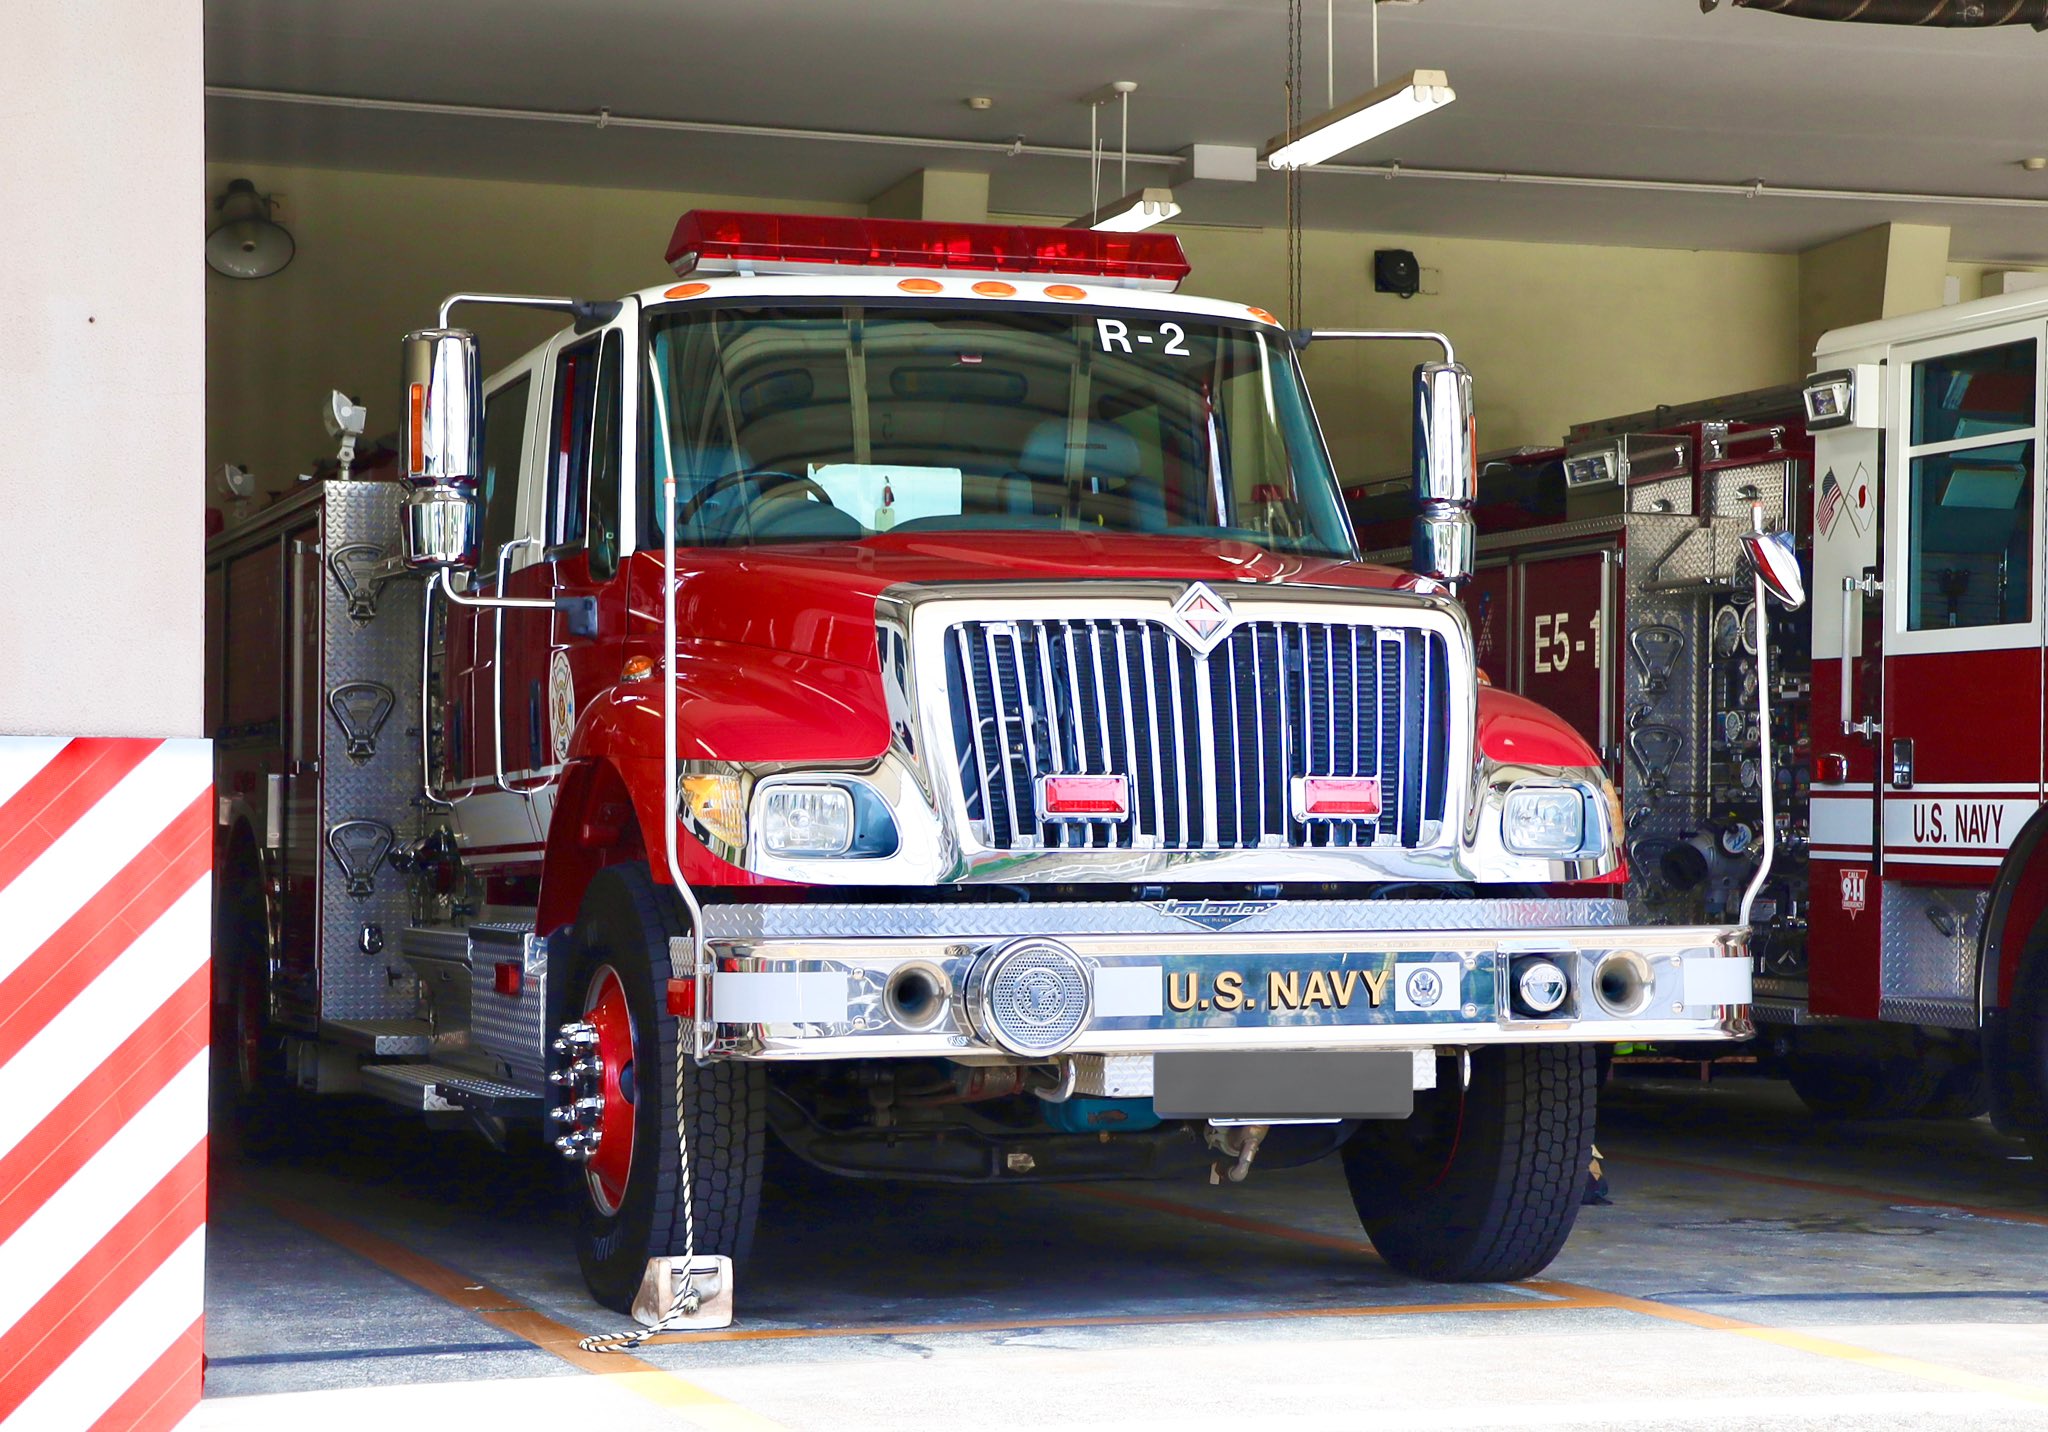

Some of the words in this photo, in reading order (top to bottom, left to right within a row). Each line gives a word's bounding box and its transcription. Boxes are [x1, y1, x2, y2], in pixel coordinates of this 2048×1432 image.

[1096, 318, 1190, 356] R-2
[1535, 609, 1601, 673] E5-1
[1913, 803, 1947, 843] U.S.
[1955, 804, 2004, 843] NAVY
[1160, 898, 1268, 916] Contender
[1166, 970, 1256, 1012] U.S.
[1266, 969, 1389, 1011] NAVY
